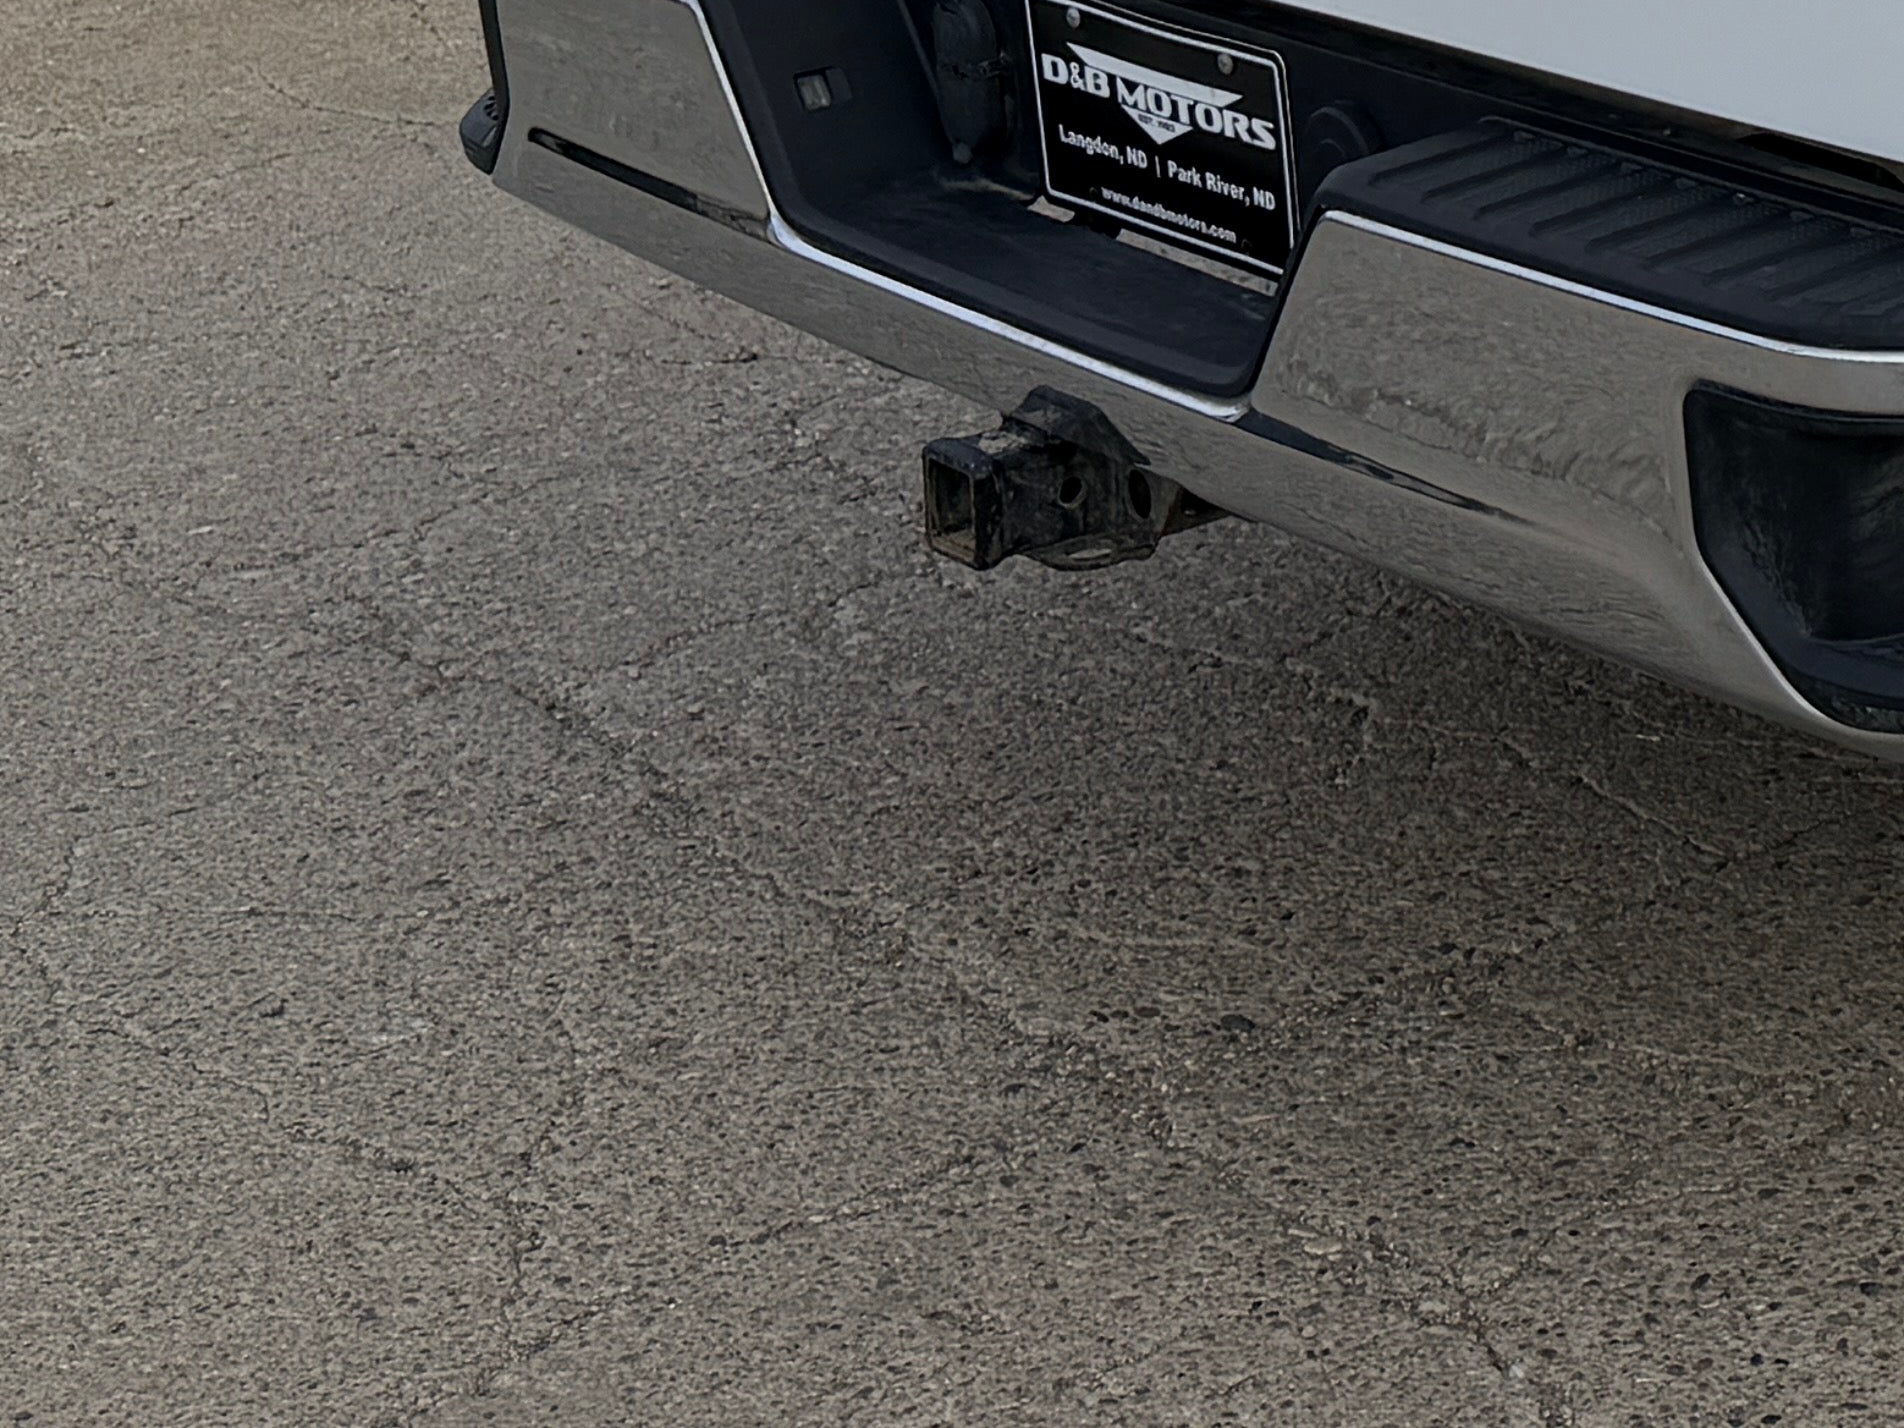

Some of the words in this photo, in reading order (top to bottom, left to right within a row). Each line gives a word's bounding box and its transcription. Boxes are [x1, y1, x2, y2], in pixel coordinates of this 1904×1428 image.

[1041, 52, 1111, 98] D&B
[1115, 75, 1277, 151] MOTORS
[1058, 123, 1125, 165] Langdon,
[1126, 145, 1148, 169] ND
[1166, 160, 1203, 187] Park
[1204, 172, 1251, 207] River,
[1252, 186, 1276, 211] ND
